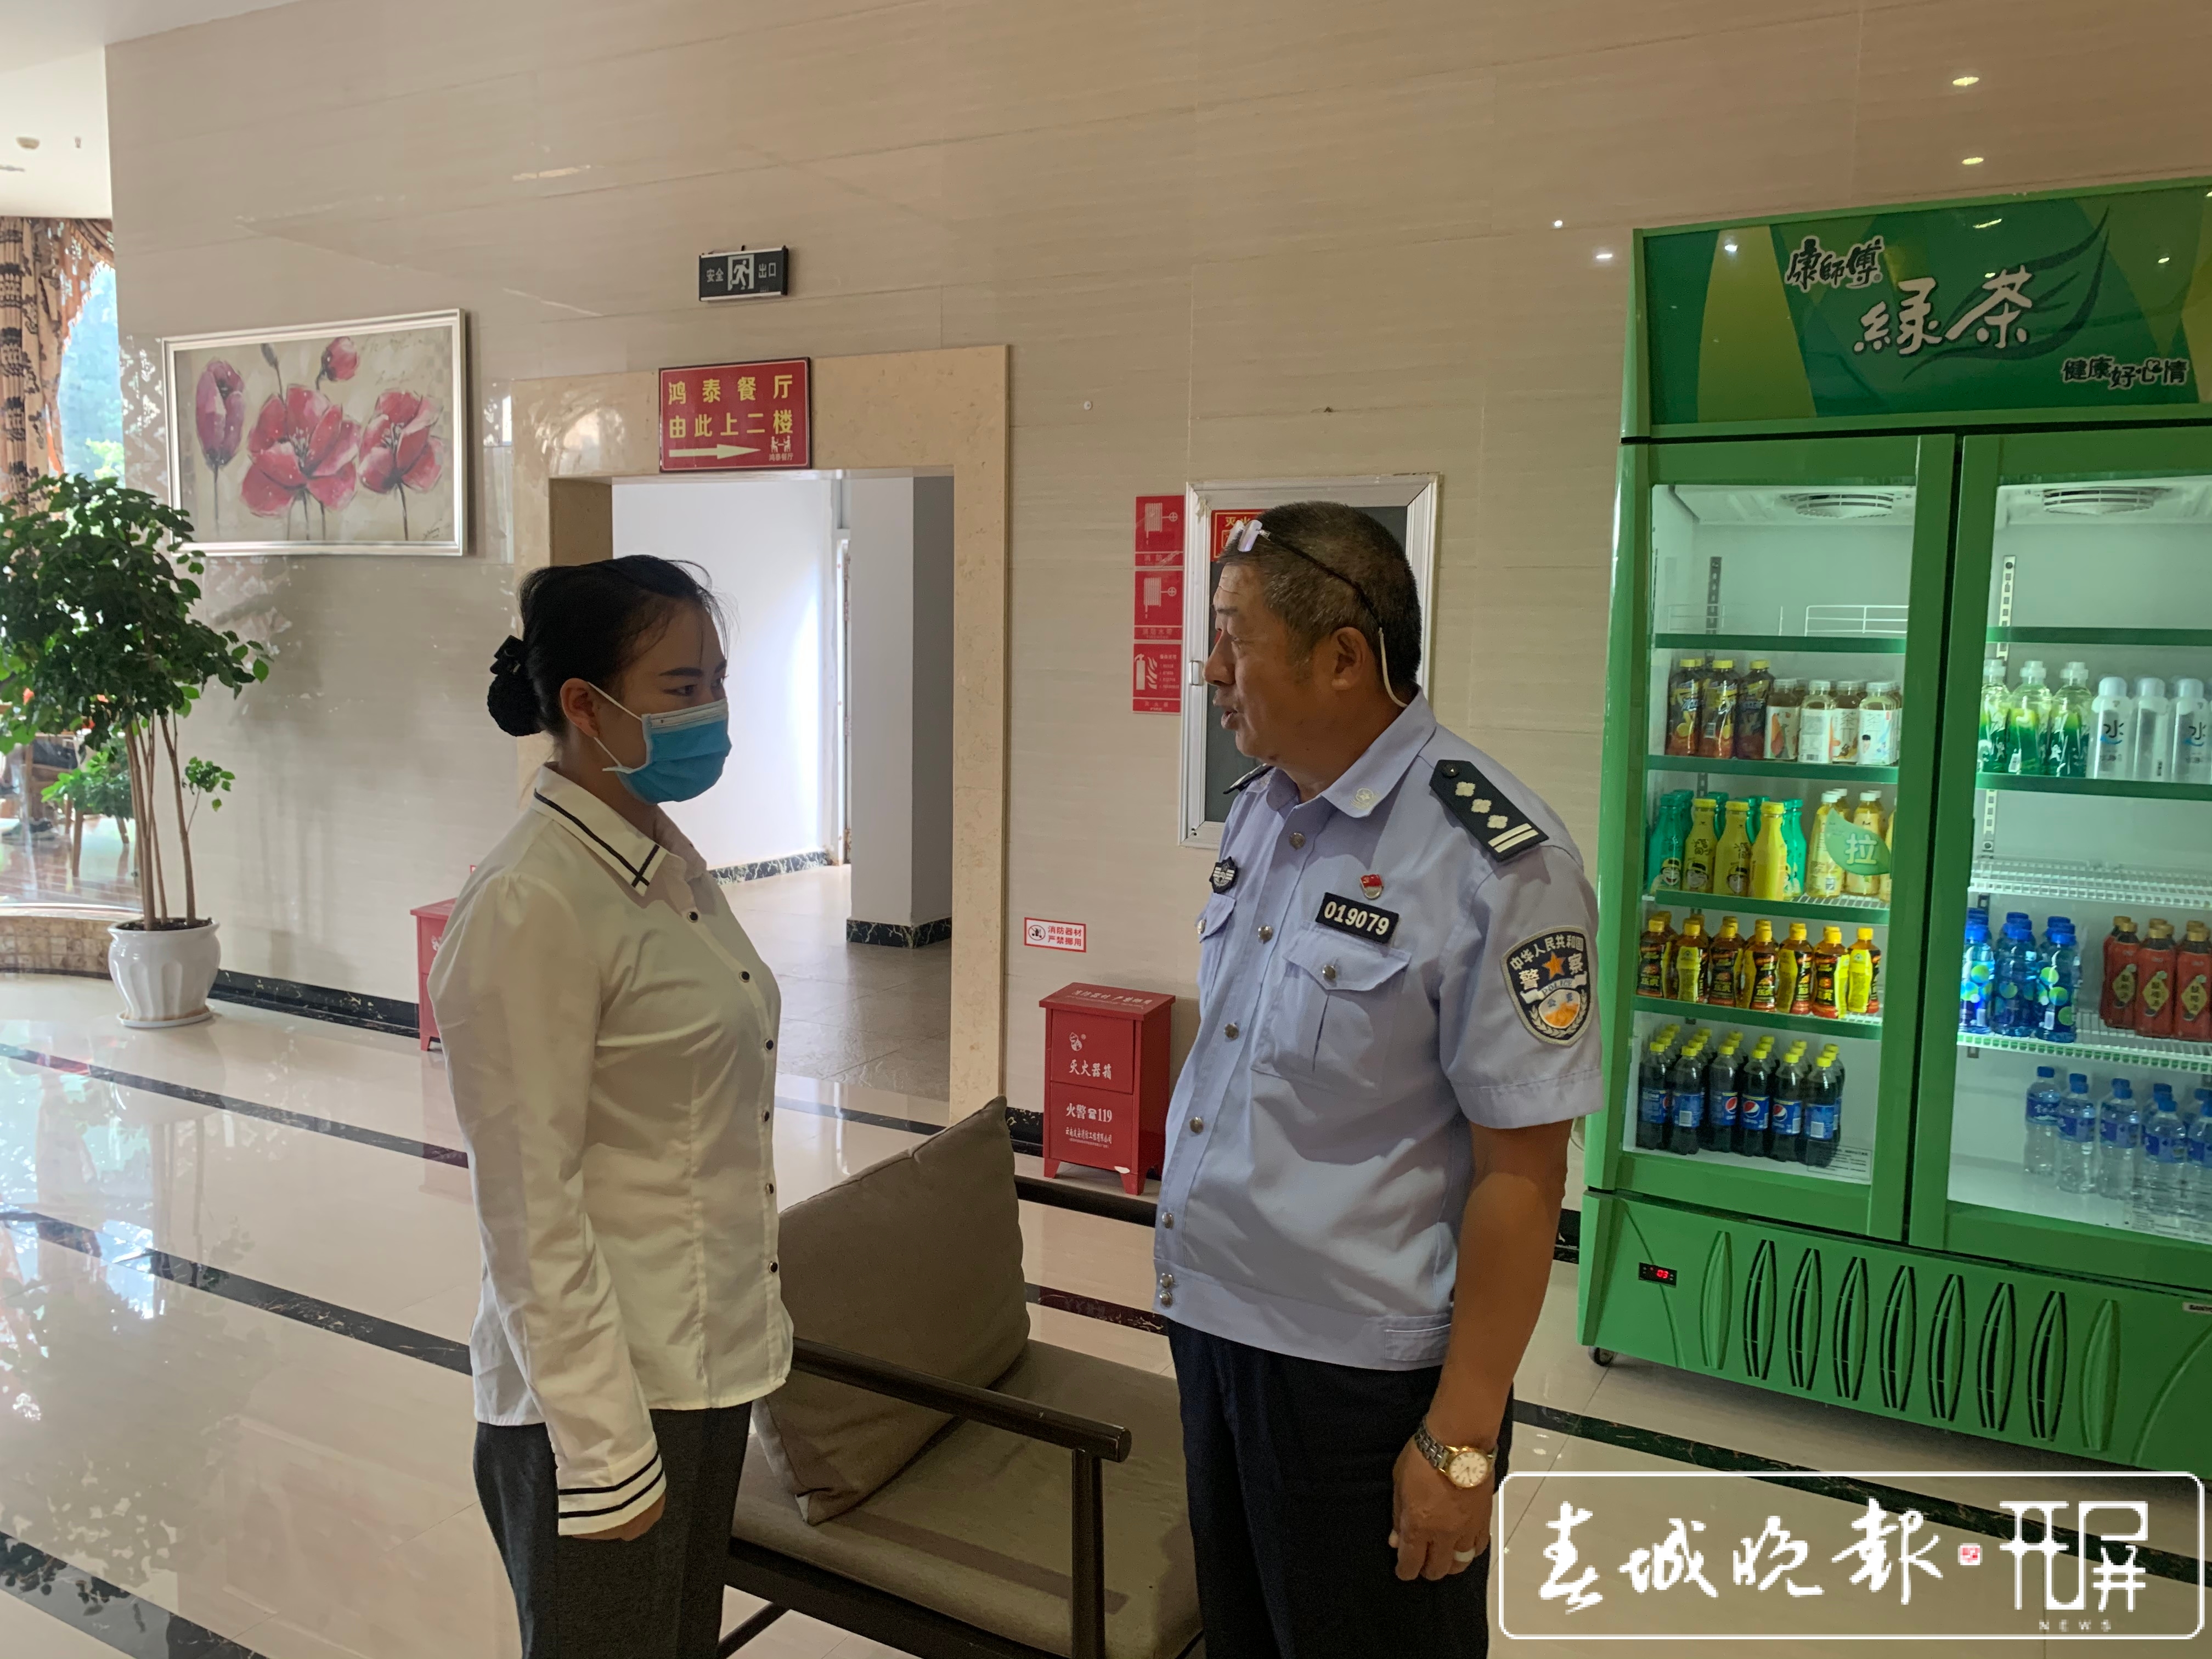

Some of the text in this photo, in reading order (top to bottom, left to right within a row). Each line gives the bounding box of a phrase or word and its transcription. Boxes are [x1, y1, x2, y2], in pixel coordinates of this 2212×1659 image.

[707, 262, 776, 283] 安全 出口
[2062, 356, 2188, 388] 健康好心情
[668, 374, 793, 405] 鸿泰餐厅
[669, 409, 793, 438] 由此上二楼
[2103, 720, 2124, 738] 水
[1845, 833, 1877, 865] 拉
[1324, 901, 1390, 935] 019079
[1048, 926, 1082, 936] 消防器材
[1048, 935, 1081, 946] 严禁挪用
[1510, 934, 1584, 970] 中华人民共和国
[1541, 979, 1573, 996] POLICE
[1069, 1059, 1111, 1080] 灭火器箱
[1066, 1103, 1113, 1122] 火警 119
